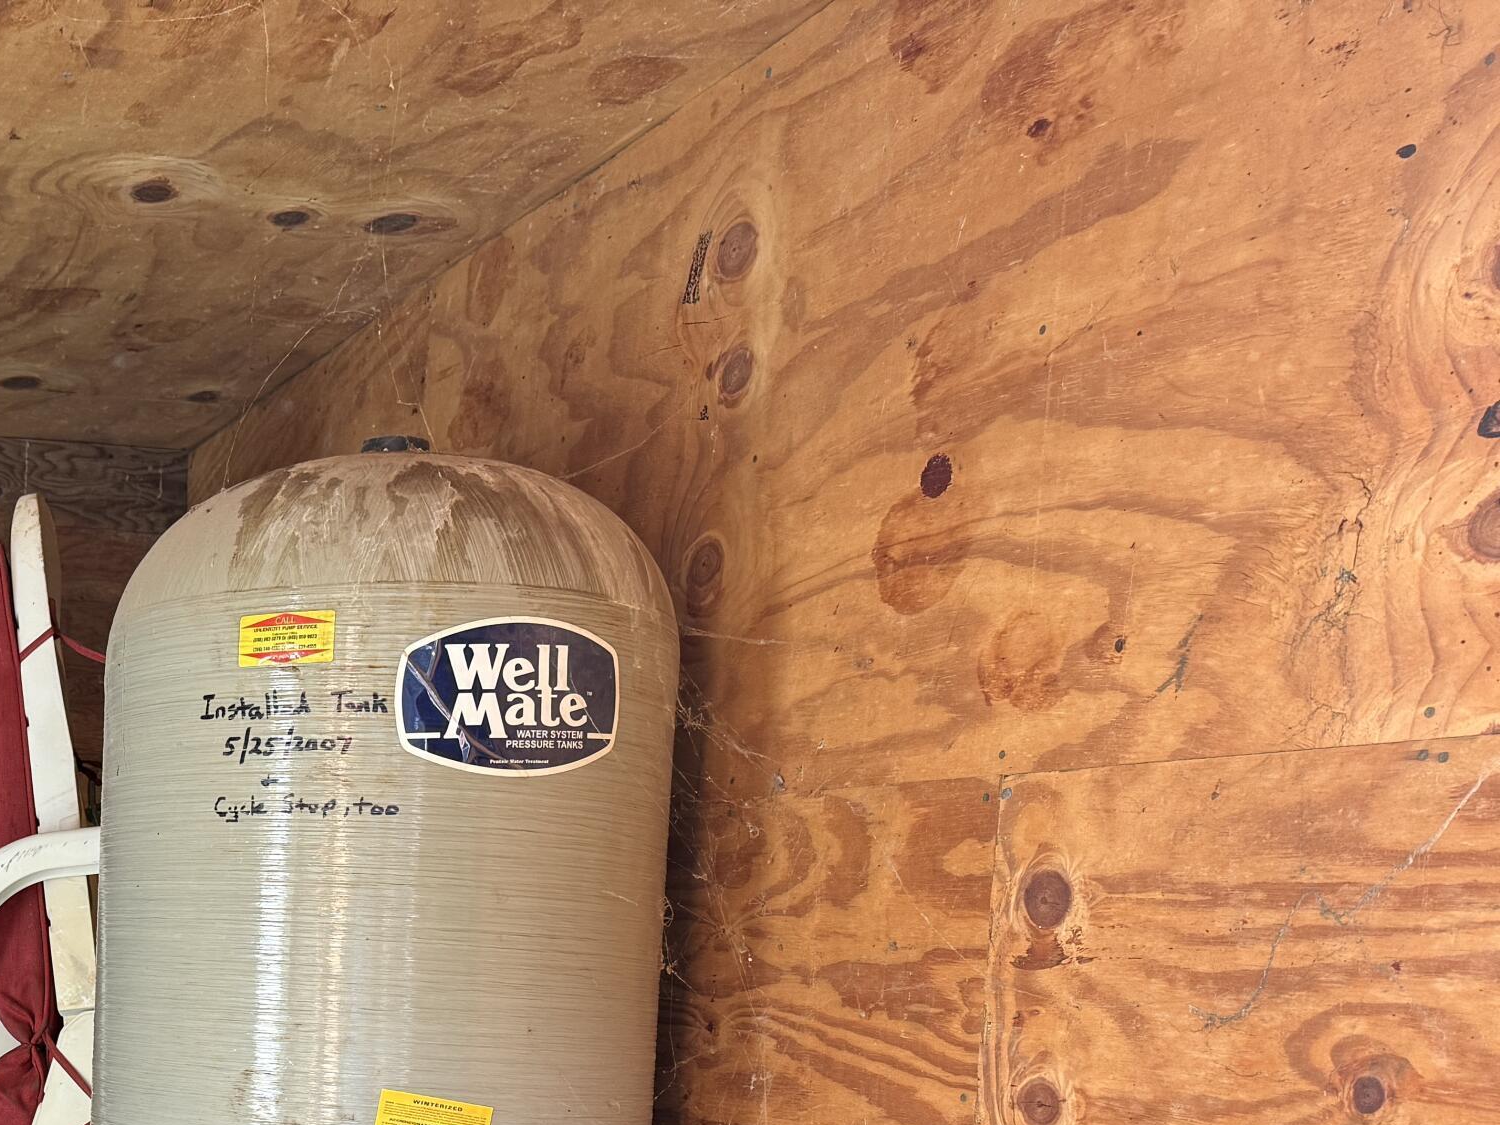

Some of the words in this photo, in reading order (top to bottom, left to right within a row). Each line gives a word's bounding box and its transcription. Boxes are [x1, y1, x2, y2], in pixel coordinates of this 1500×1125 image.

[445, 643, 570, 693] Well
[331, 690, 389, 714] Tank
[443, 690, 588, 739] Mate
[222, 726, 353, 765] 5/25/2007
[505, 740, 555, 749] PRESSURE
[556, 740, 584, 750] TANKS
[516, 730, 549, 739] WATER
[550, 730, 584, 740] SYSTEM
[413, 1099, 463, 1112] WINTERIZED
